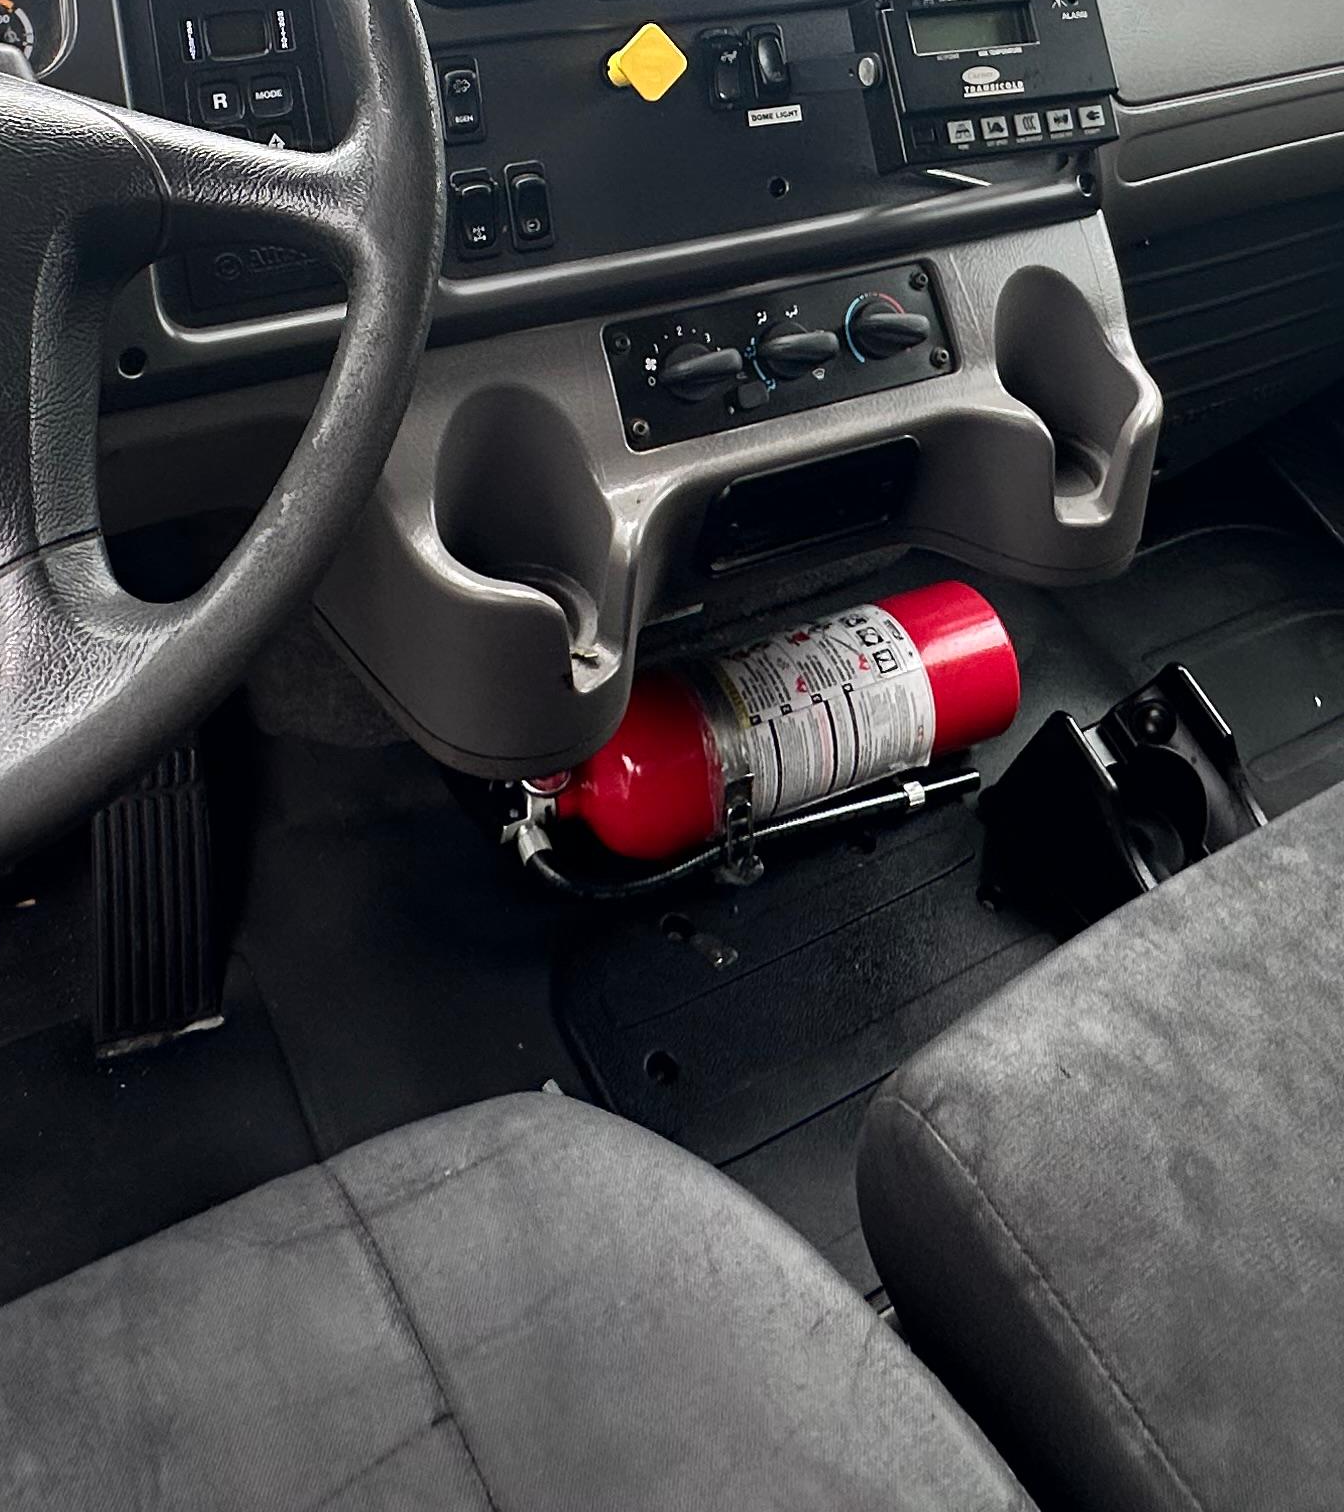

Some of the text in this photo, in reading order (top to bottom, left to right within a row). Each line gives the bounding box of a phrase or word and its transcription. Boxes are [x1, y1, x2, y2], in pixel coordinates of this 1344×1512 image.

[255, 89, 283, 100] MODE
[212, 93, 228, 109] R
[750, 109, 798, 122] DOME LIGHT
[676, 325, 683, 336] 2
